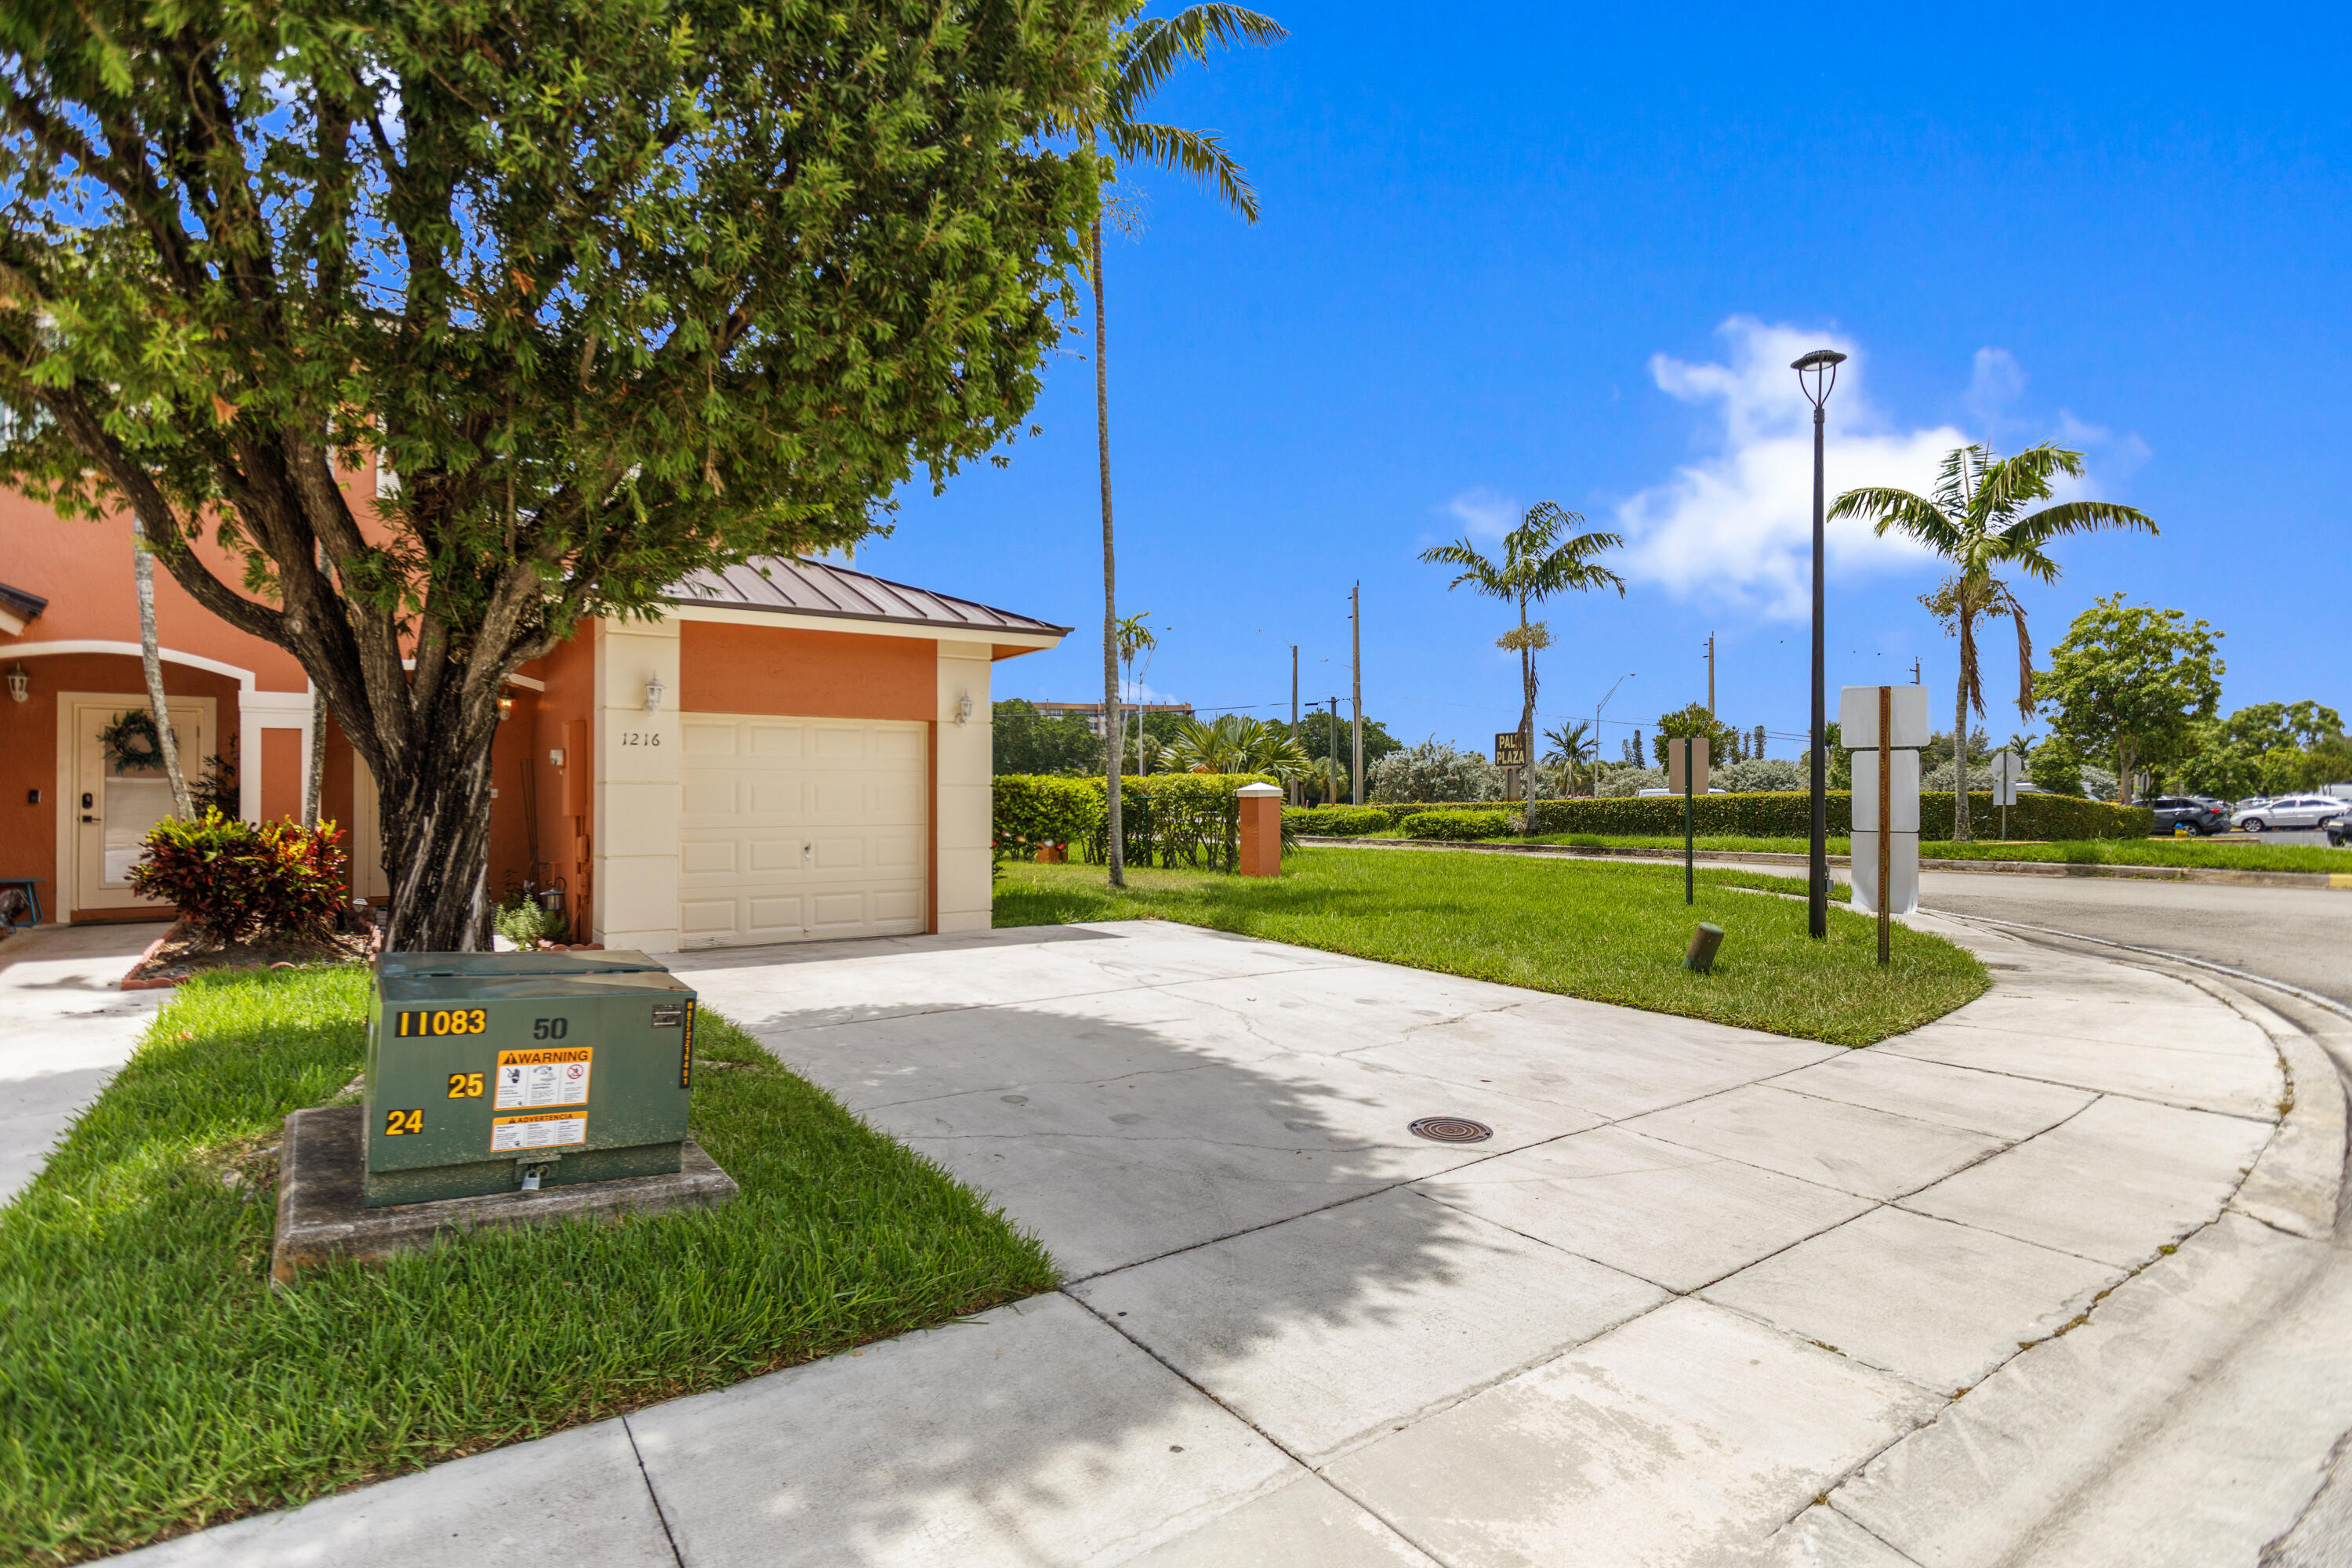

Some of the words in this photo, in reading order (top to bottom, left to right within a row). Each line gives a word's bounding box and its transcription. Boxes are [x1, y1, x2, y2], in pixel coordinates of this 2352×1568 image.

[622, 732, 660, 746] 1216
[1496, 750, 1525, 765] PLAZA
[400, 1009, 487, 1036] 11083
[533, 1018, 568, 1040] 50
[518, 1051, 588, 1064] WARNING
[448, 1073, 484, 1098] 25
[385, 1109, 423, 1135] 24
[517, 1113, 573, 1123] ADVERTENCIA
